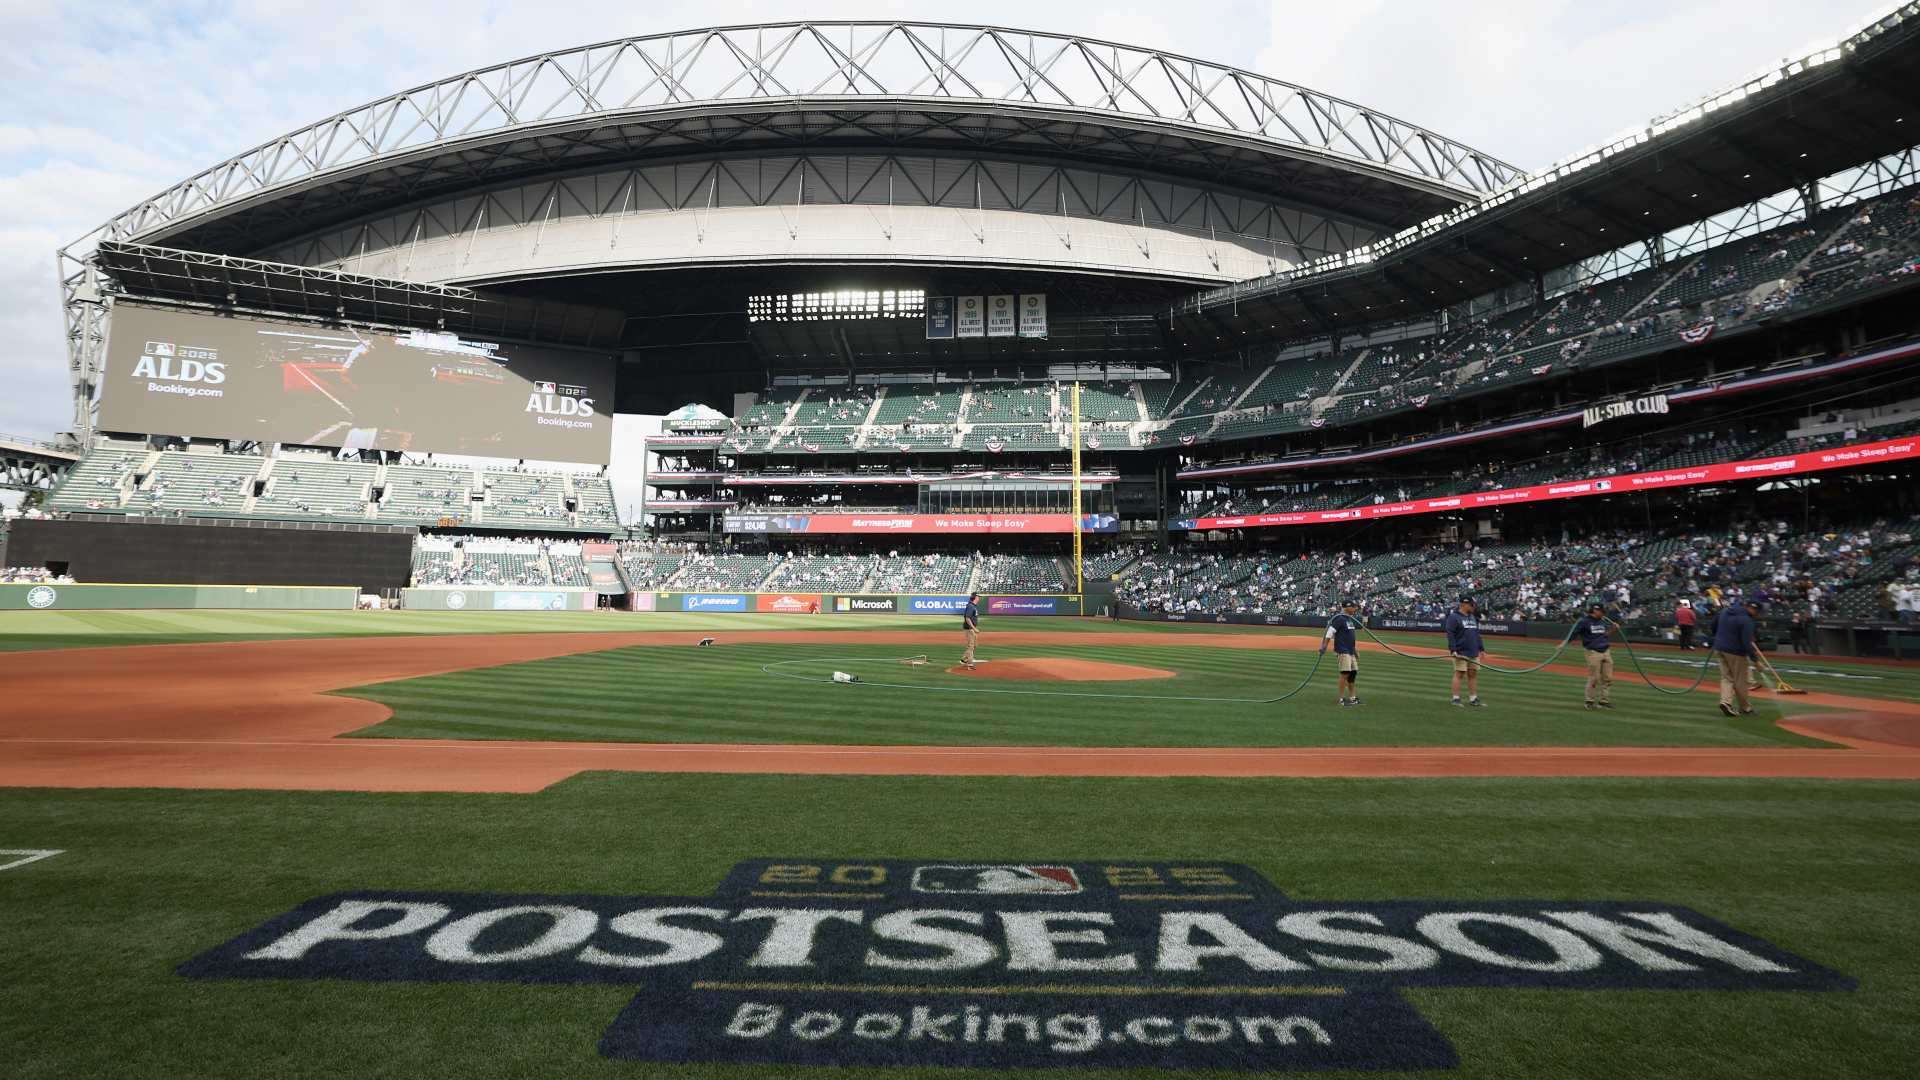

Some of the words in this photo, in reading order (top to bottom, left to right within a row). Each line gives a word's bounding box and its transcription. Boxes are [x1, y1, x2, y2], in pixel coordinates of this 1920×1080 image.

[178, 349, 217, 360] 2025
[131, 355, 225, 384] ALDS
[147, 382, 223, 397] Booking.com
[525, 393, 594, 417] ALDS
[1635, 394, 1669, 414] CLUB
[537, 416, 593, 429] Booking.com
[1836, 452, 1860, 460] Make
[1860, 448, 1888, 457] Sleep
[935, 519, 949, 527] We
[951, 519, 974, 527] Make
[976, 519, 1002, 528] Sleep
[851, 599, 893, 609] Microsoft
[914, 599, 954, 609] GLOBAL
[758, 864, 888, 886] 20
[1103, 864, 1239, 887] 25
[242, 900, 1797, 973] POSTSEASON
[724, 1001, 1333, 1053] Booking.com
